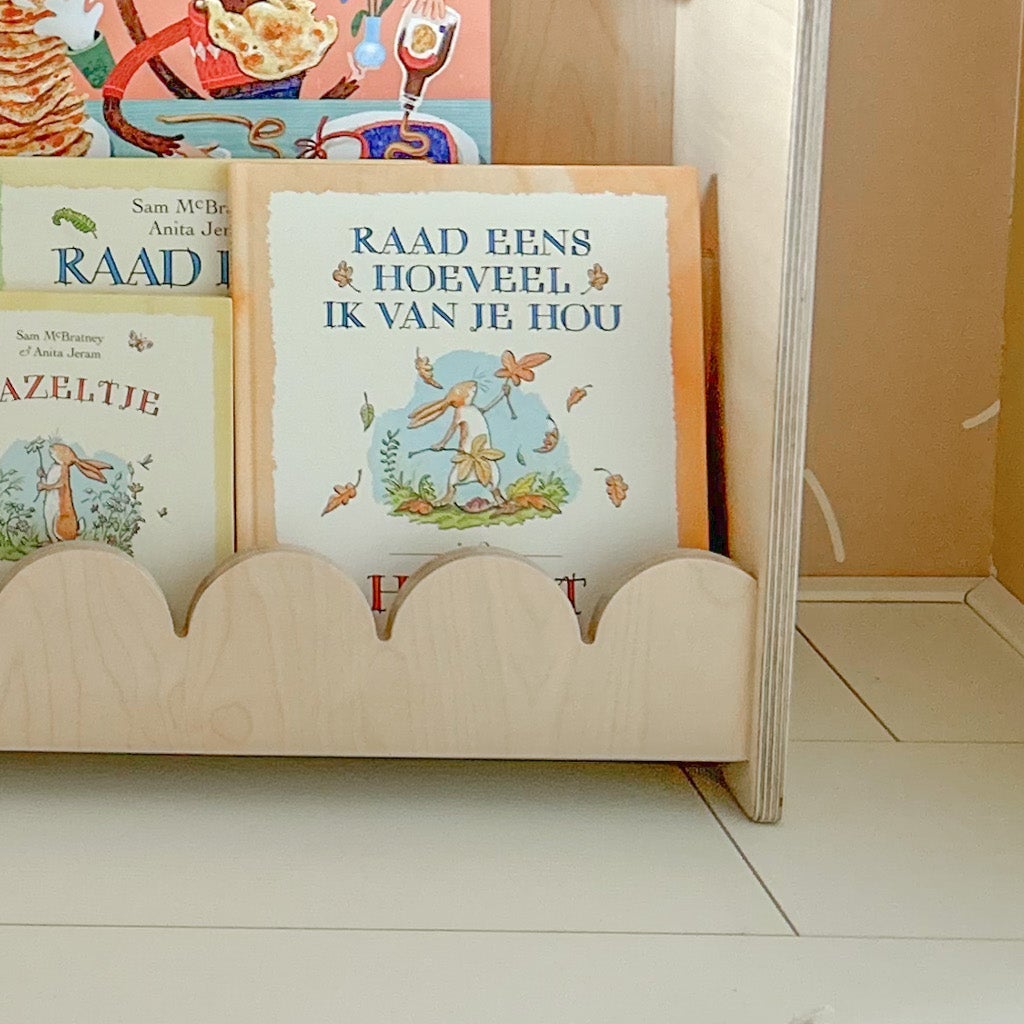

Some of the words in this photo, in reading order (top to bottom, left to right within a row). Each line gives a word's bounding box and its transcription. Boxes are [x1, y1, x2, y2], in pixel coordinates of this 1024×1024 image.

[131, 198, 169, 214] Sam
[148, 220, 195, 236] Anita
[351, 226, 469, 257] RAAD
[486, 227, 591, 258] EENS
[51, 246, 202, 289] RAAD
[372, 264, 571, 295] HOEVEEL
[323, 301, 366, 329] IK
[375, 300, 458, 330] VAN
[470, 302, 513, 333] JE
[528, 303, 623, 333] HOU
[16, 329, 40, 342] Sam
[43, 330, 104, 346] McBratney
[34, 346, 63, 358] Anita
[67, 347, 102, 359] Jeram
